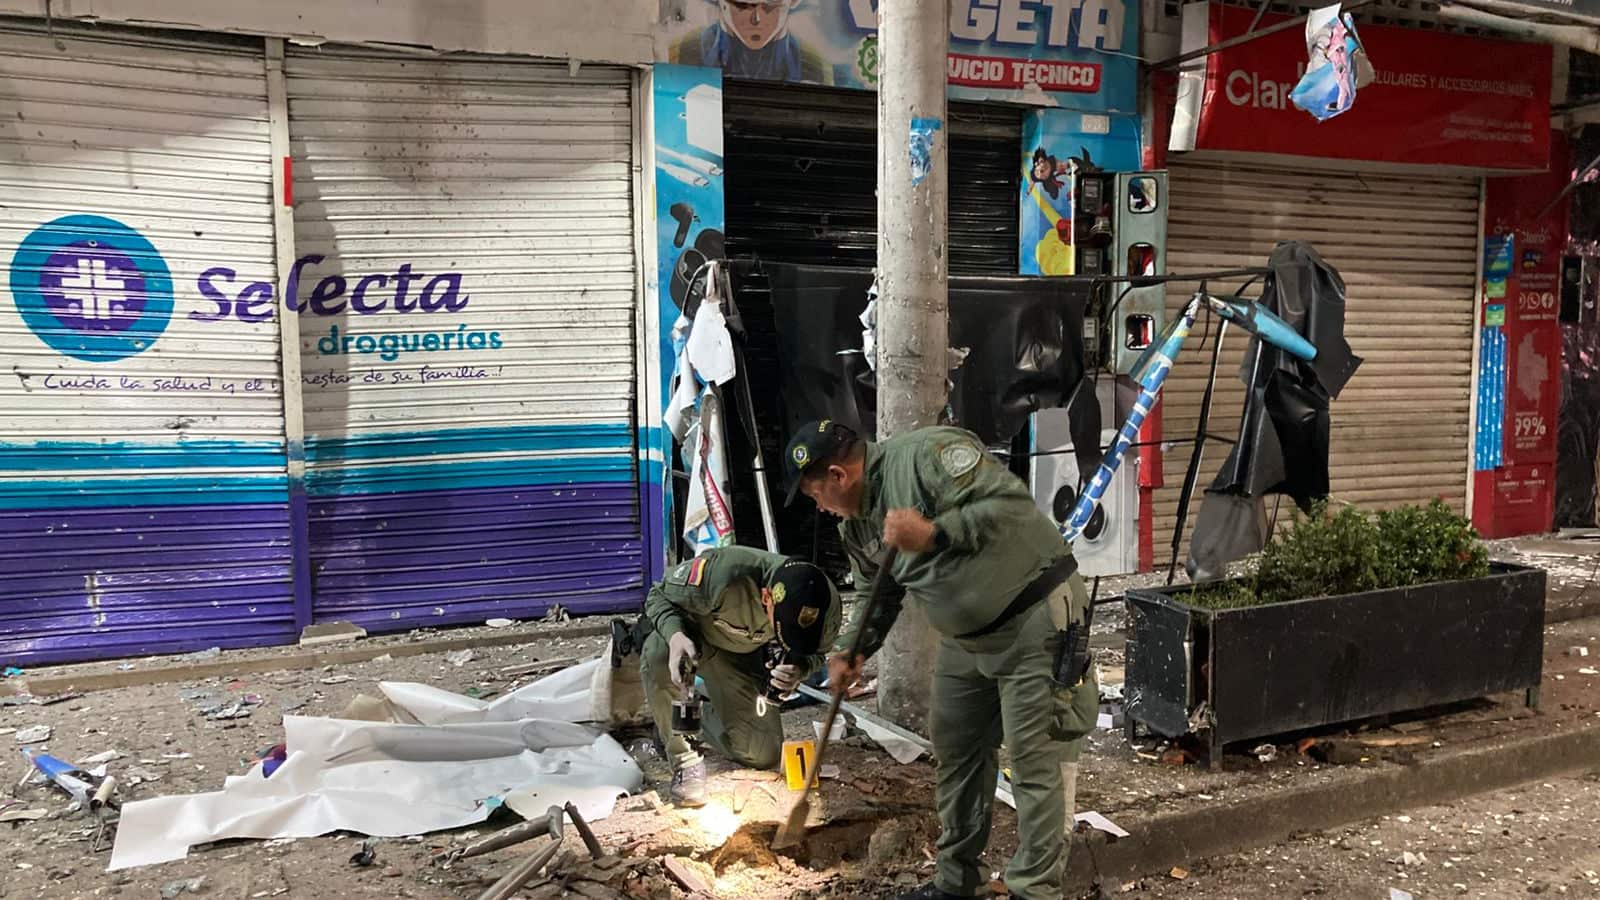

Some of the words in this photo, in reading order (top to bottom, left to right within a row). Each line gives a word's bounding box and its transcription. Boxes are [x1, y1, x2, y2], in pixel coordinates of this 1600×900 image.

[947, 57, 1004, 81] VICIO
[1012, 59, 1095, 87] TÉCNICO
[1375, 72, 1427, 88] LULARES
[1225, 69, 1290, 110] Clar
[188, 254, 470, 324] Selecta
[318, 325, 503, 361] droguerías
[43, 373, 111, 390] Cuida
[120, 375, 144, 390] la
[153, 376, 212, 392] salud
[220, 382, 235, 395] y
[244, 378, 265, 392] el
[363, 368, 385, 384] de
[391, 371, 413, 385] su
[795, 747, 807, 781] 1
